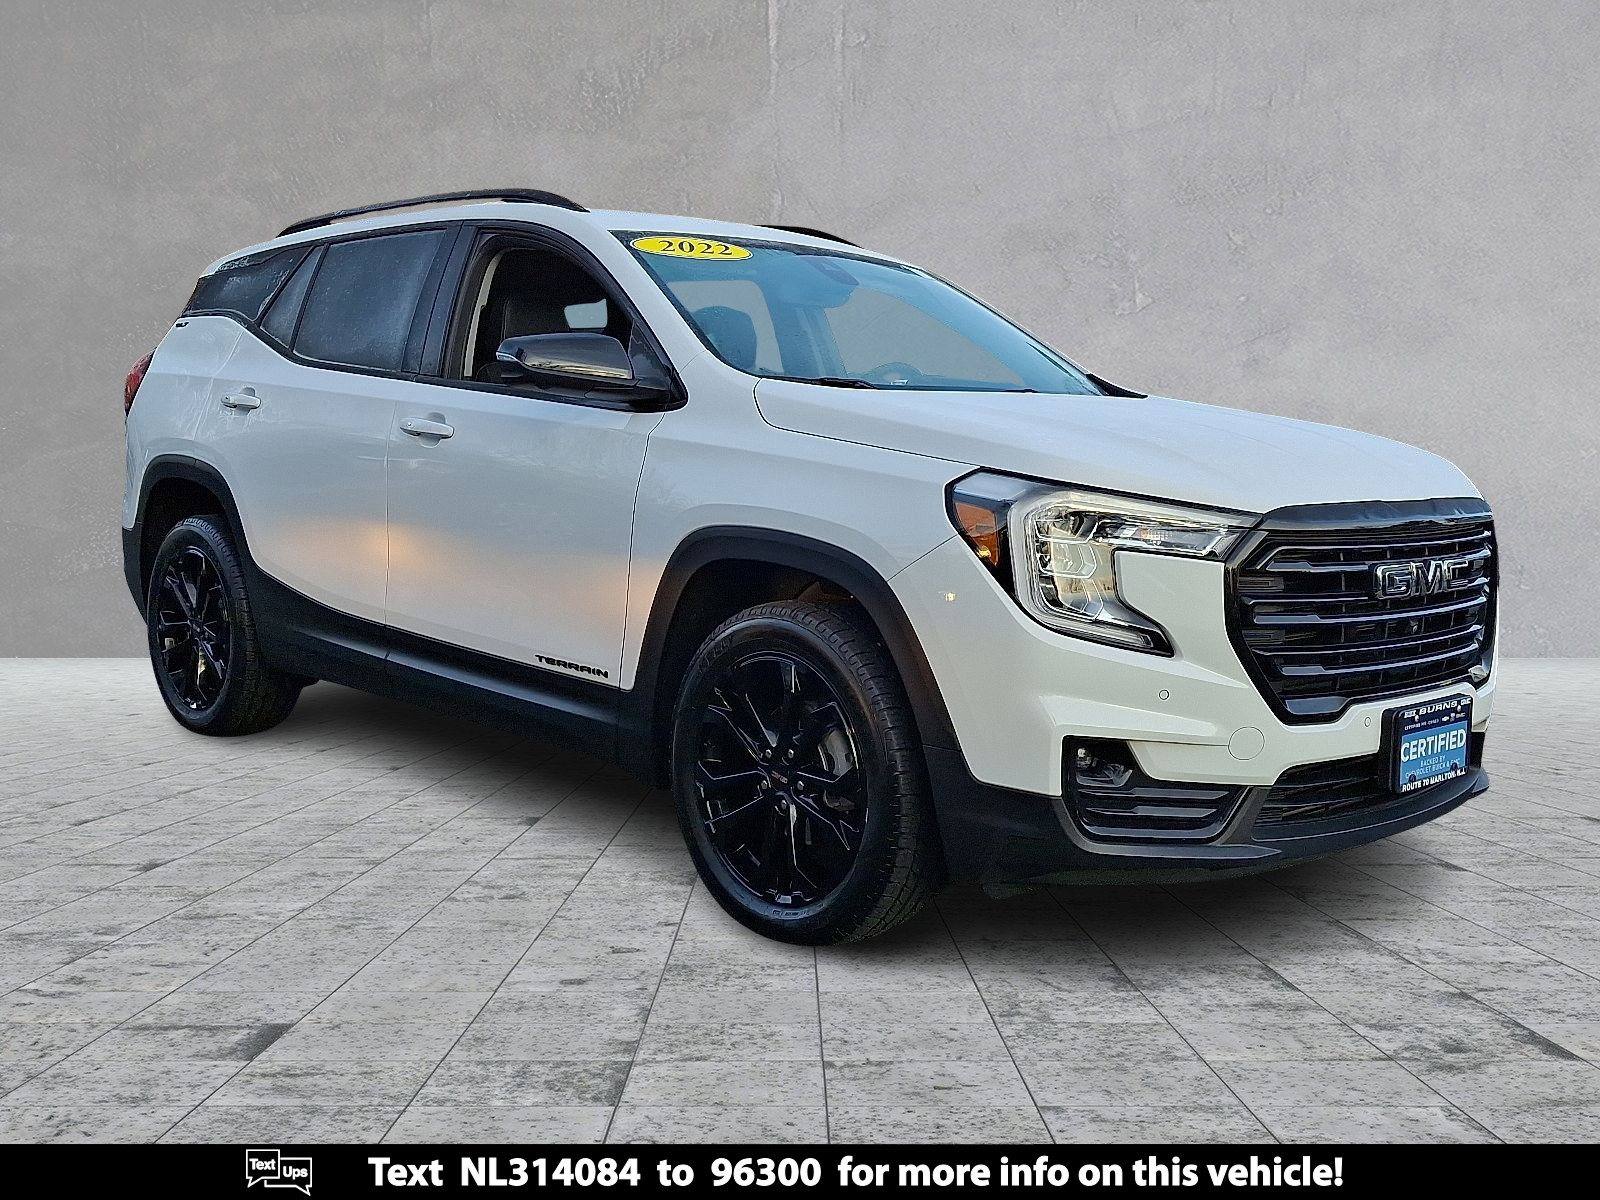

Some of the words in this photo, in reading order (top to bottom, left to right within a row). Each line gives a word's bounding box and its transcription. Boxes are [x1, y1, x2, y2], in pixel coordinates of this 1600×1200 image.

[658, 240, 733, 255] 2022
[1375, 559, 1469, 599] GMC
[534, 654, 609, 679] TERRAIN
[1419, 700, 1458, 715] BURNS
[1401, 728, 1466, 762] CERTIFIED
[1420, 757, 1439, 767] BACKED
[1439, 755, 1446, 763] BY
[1402, 780, 1422, 793] ROUTE
